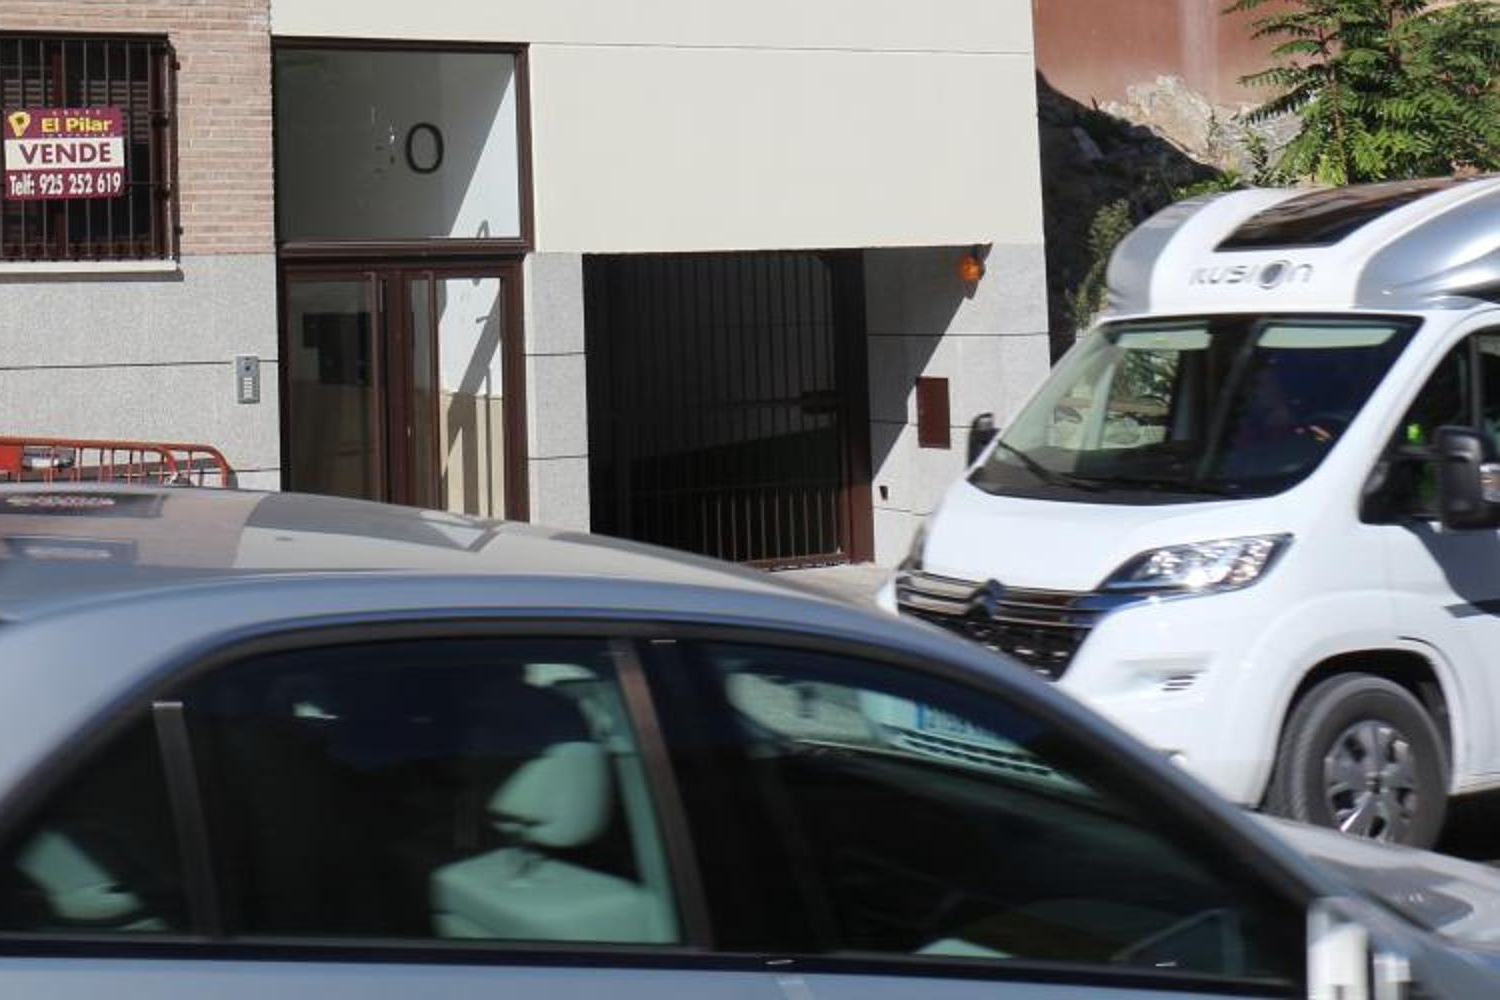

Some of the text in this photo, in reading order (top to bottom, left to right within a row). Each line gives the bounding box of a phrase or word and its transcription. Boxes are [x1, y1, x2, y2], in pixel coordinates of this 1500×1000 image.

[41, 117, 113, 133] El Pilar
[19, 142, 111, 165] VENDE
[39, 174, 64, 195] 925
[68, 173, 93, 195] 252
[97, 172, 121, 193] 619
